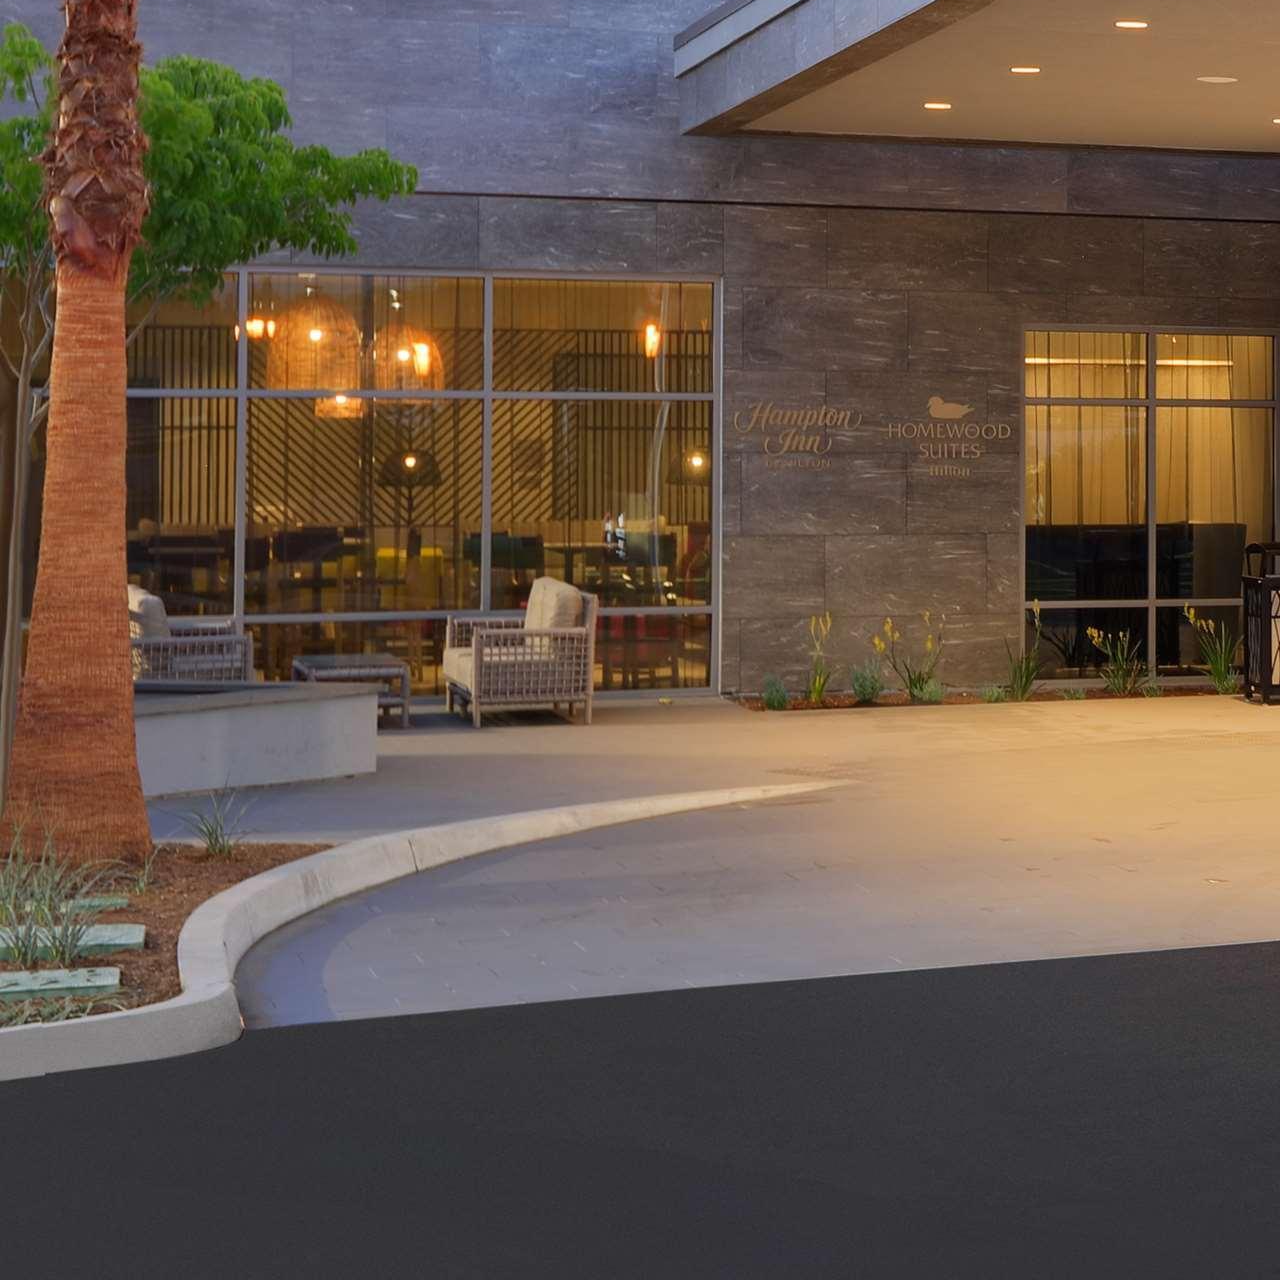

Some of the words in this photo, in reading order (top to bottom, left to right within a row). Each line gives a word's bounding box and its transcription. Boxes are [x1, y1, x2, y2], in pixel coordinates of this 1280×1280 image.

[734, 401, 862, 433] Hampton
[888, 423, 1011, 439] HOMEWOOD
[764, 429, 832, 456] Inn
[919, 443, 981, 459] SUITES
